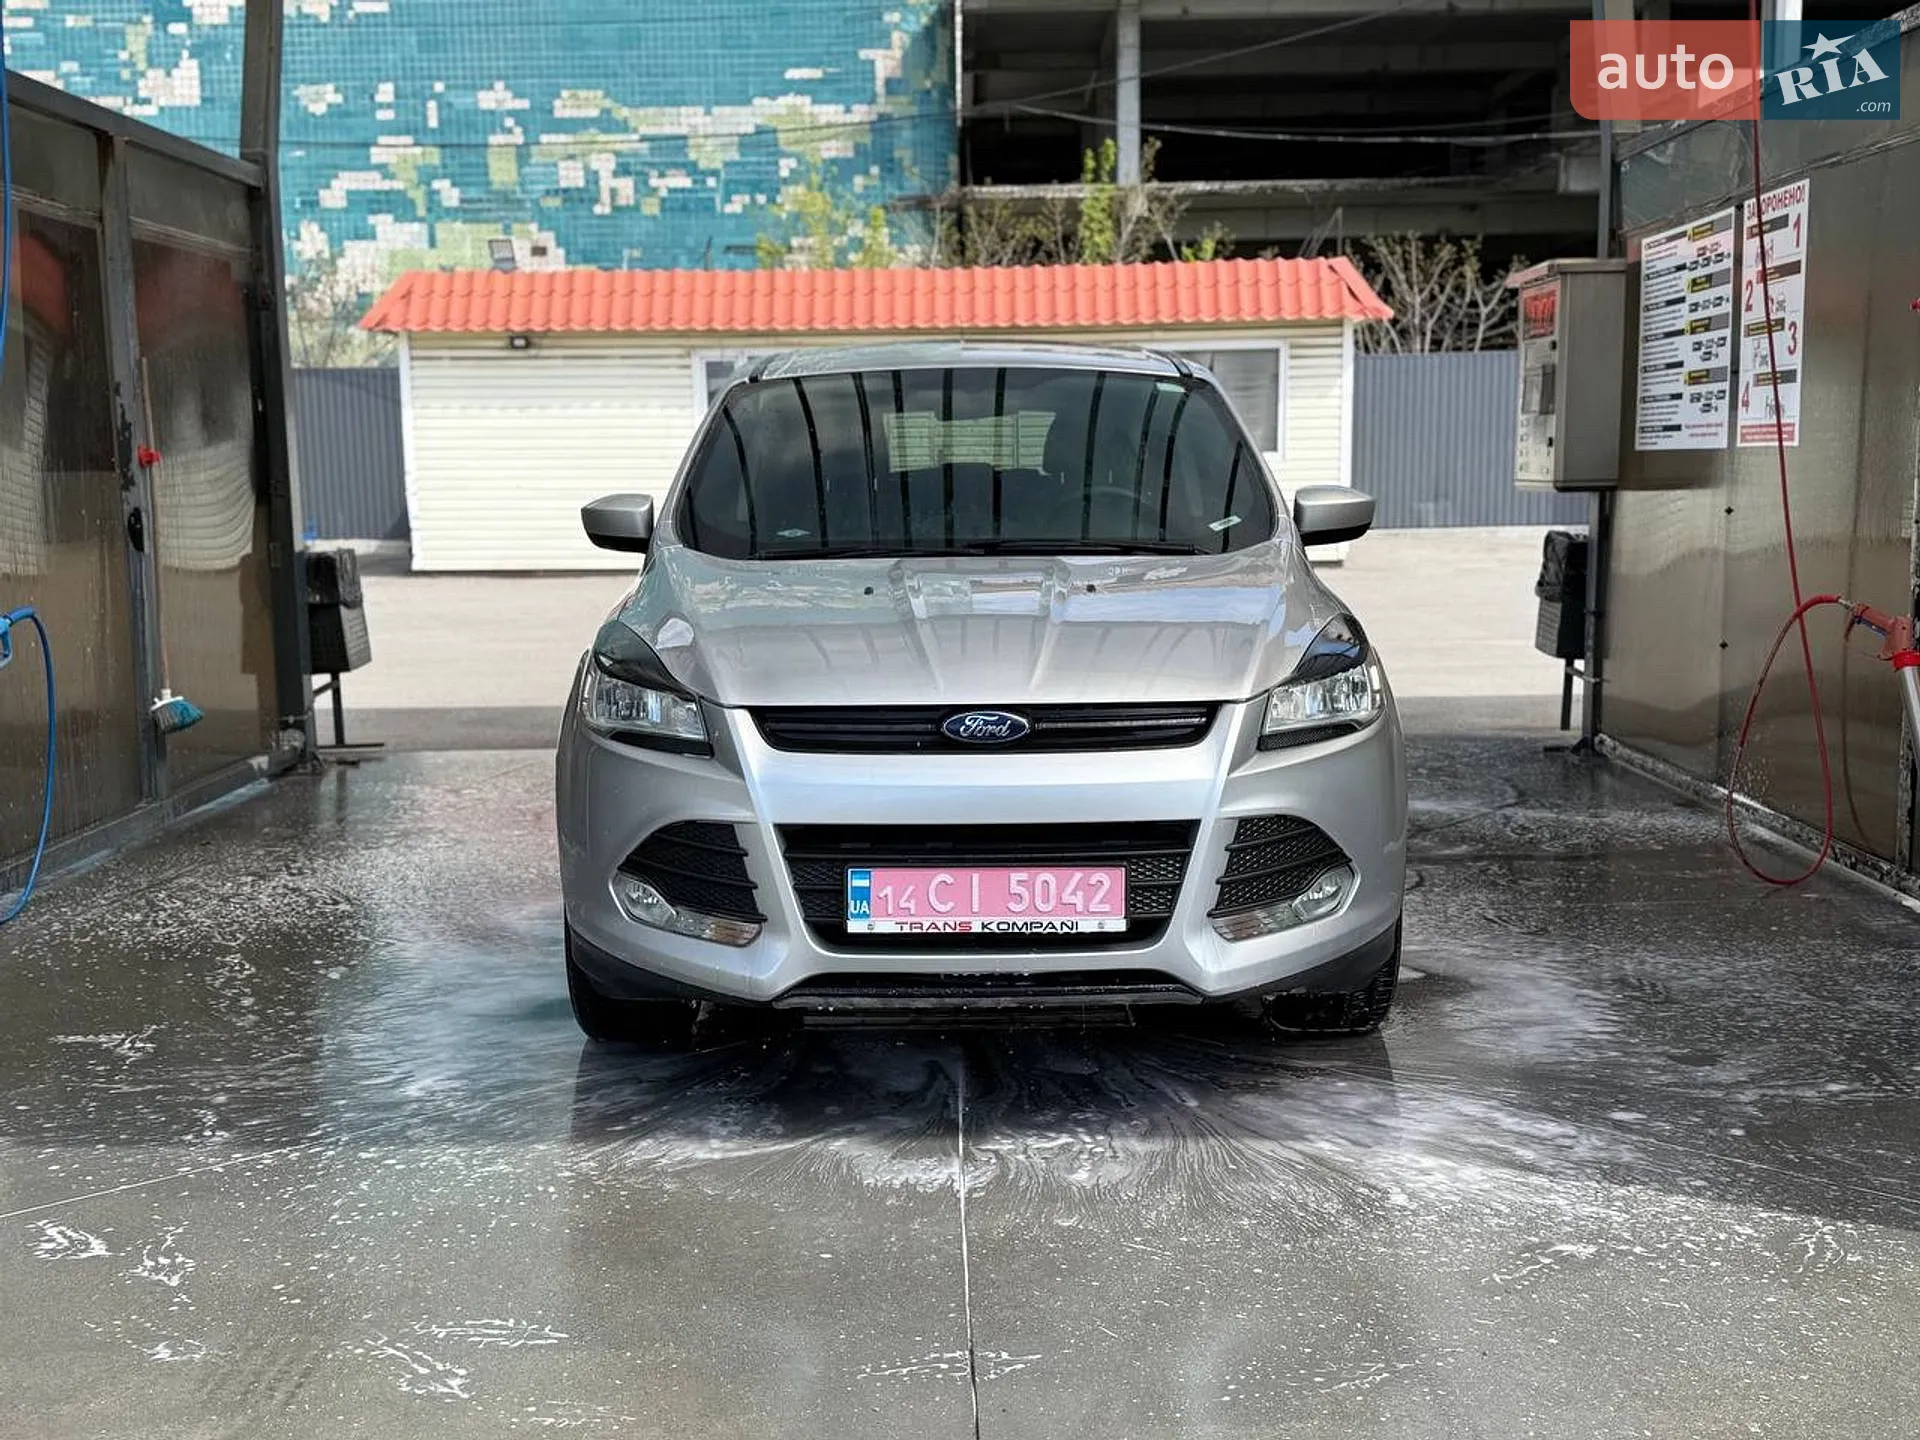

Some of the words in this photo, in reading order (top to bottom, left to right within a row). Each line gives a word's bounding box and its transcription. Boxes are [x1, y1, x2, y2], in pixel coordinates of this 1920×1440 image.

[1746, 183, 1806, 220] ЗАОРОНЕНО!
[1793, 213, 1801, 248] 1
[1745, 280, 1753, 312] 2
[1788, 321, 1798, 355] 3
[1742, 381, 1750, 415] 4
[960, 715, 1012, 737] Ford
[850, 900, 870, 914] UA
[876, 885, 917, 915] 14
[1006, 872, 1112, 914] 5042
[895, 920, 973, 932] TRANS
[981, 920, 1079, 932] KOMPANI
